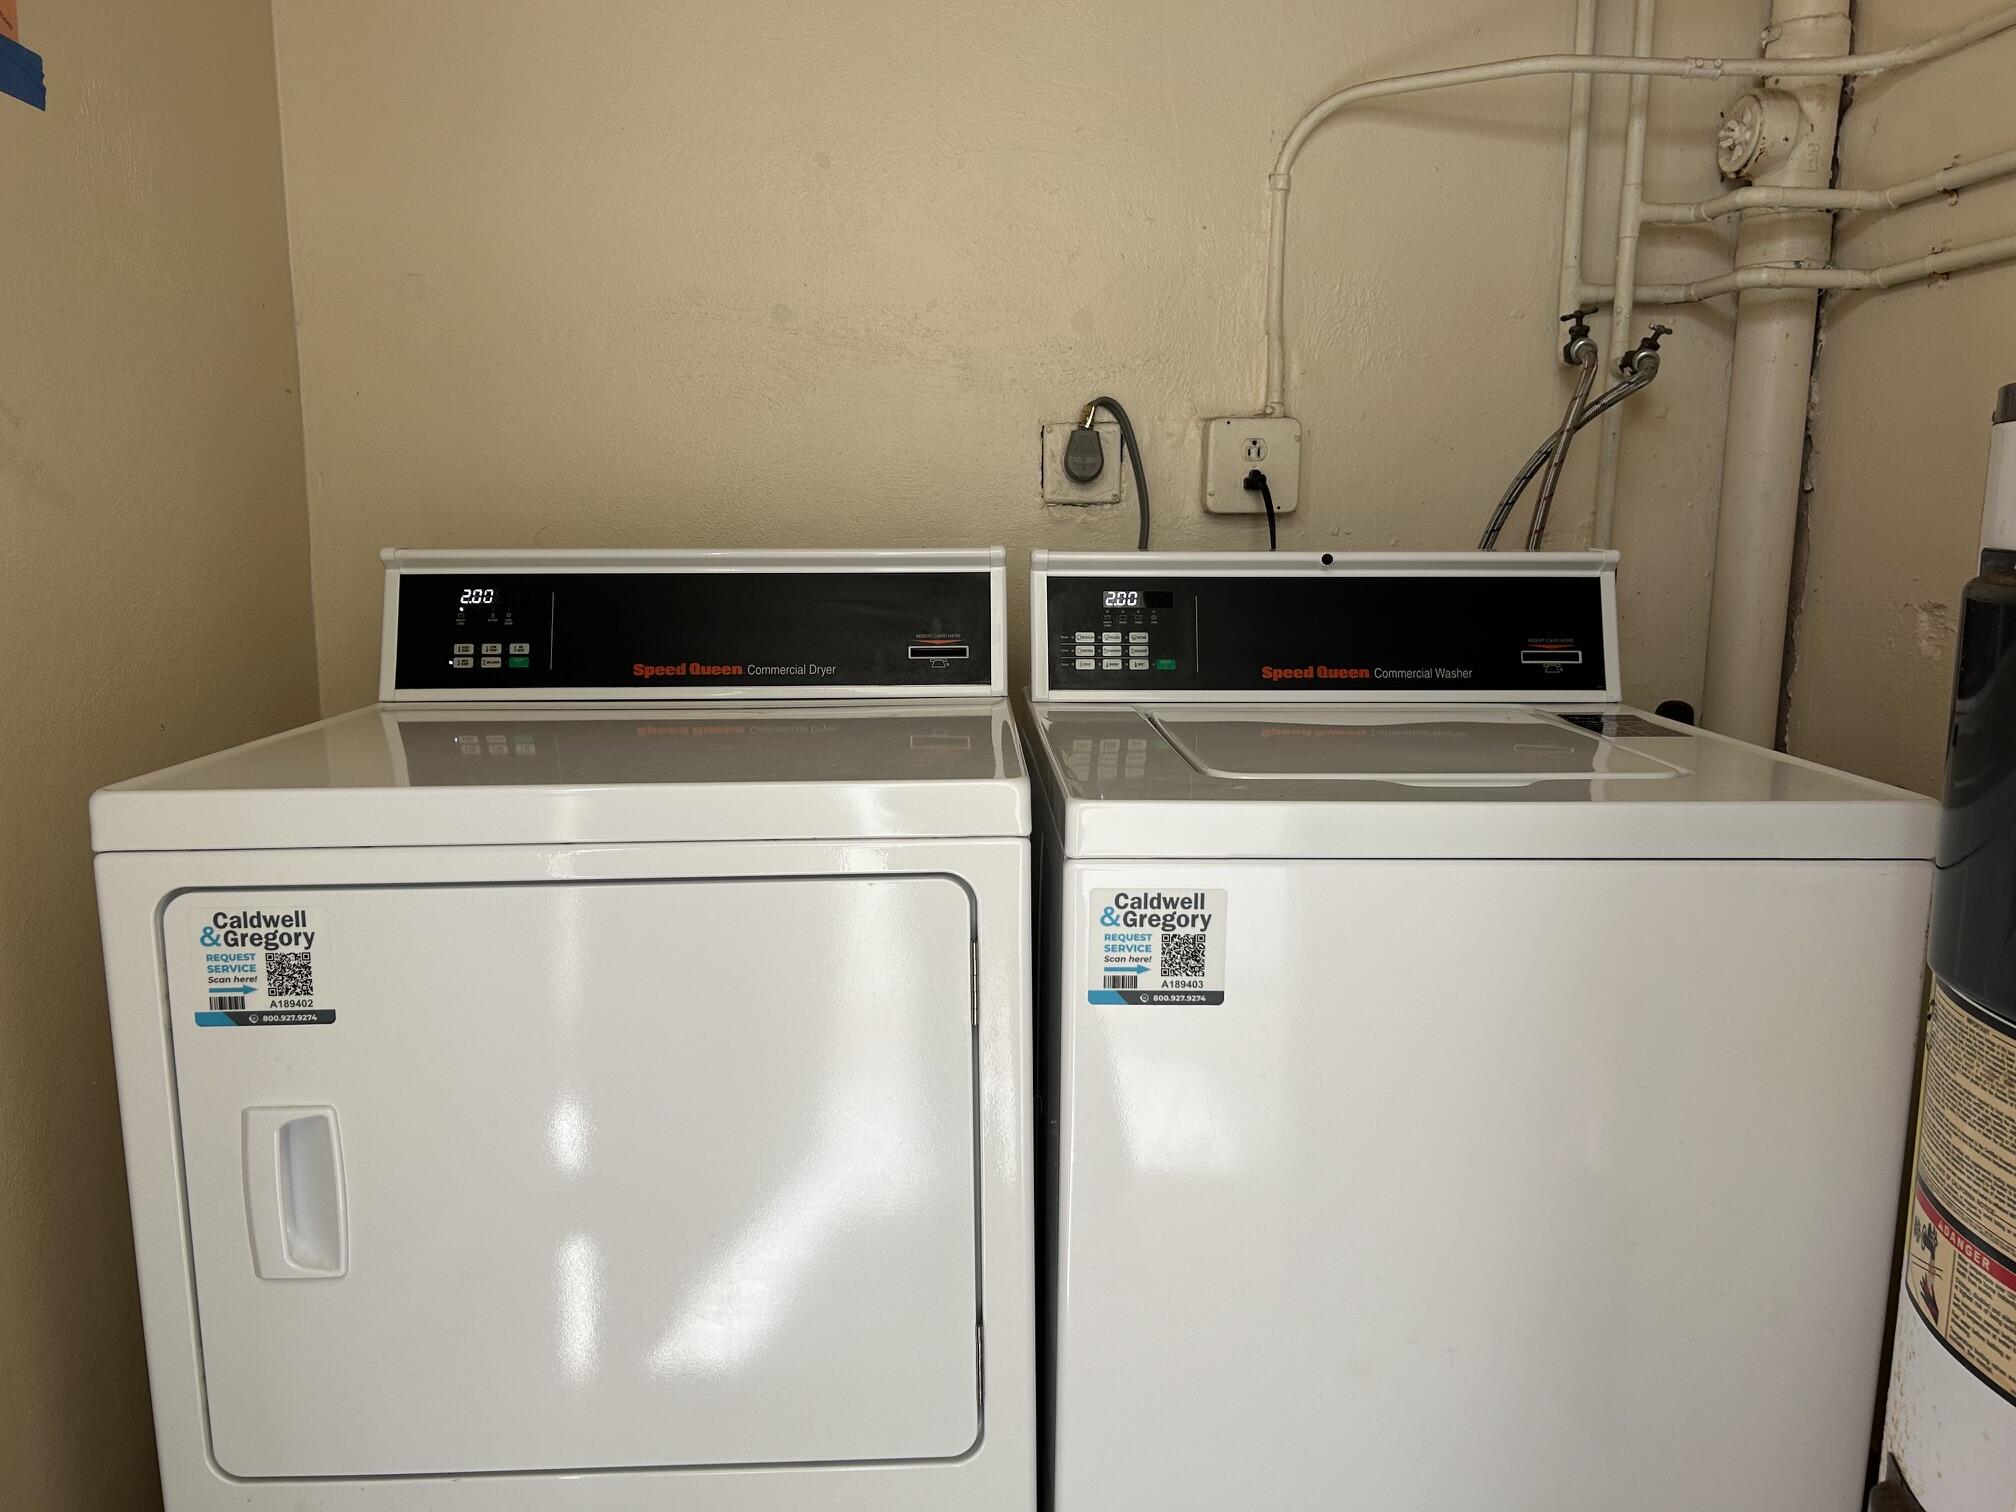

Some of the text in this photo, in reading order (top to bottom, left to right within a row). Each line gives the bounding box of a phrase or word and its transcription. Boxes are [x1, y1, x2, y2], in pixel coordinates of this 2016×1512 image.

[460, 589, 494, 604] 2.00
[1105, 591, 1138, 606] 2.00
[633, 662, 837, 679] Speed Queen Commercial Dryer
[1261, 666, 1473, 682] Speed Queen Commercial Washer
[1114, 892, 1205, 910] Caldwell
[212, 910, 307, 929] Caldwell
[1104, 933, 1152, 942] REQUEST
[1104, 944, 1152, 953] SERVICE
[206, 953, 256, 962] REQUEST
[1104, 955, 1152, 963] Scan here!
[207, 964, 257, 973] SERVICE
[1161, 980, 1204, 989] A189403
[269, 999, 314, 1008] A189402
[262, 1014, 318, 1022] 800.927.9274
[1944, 1226, 1992, 1272] DANGER
